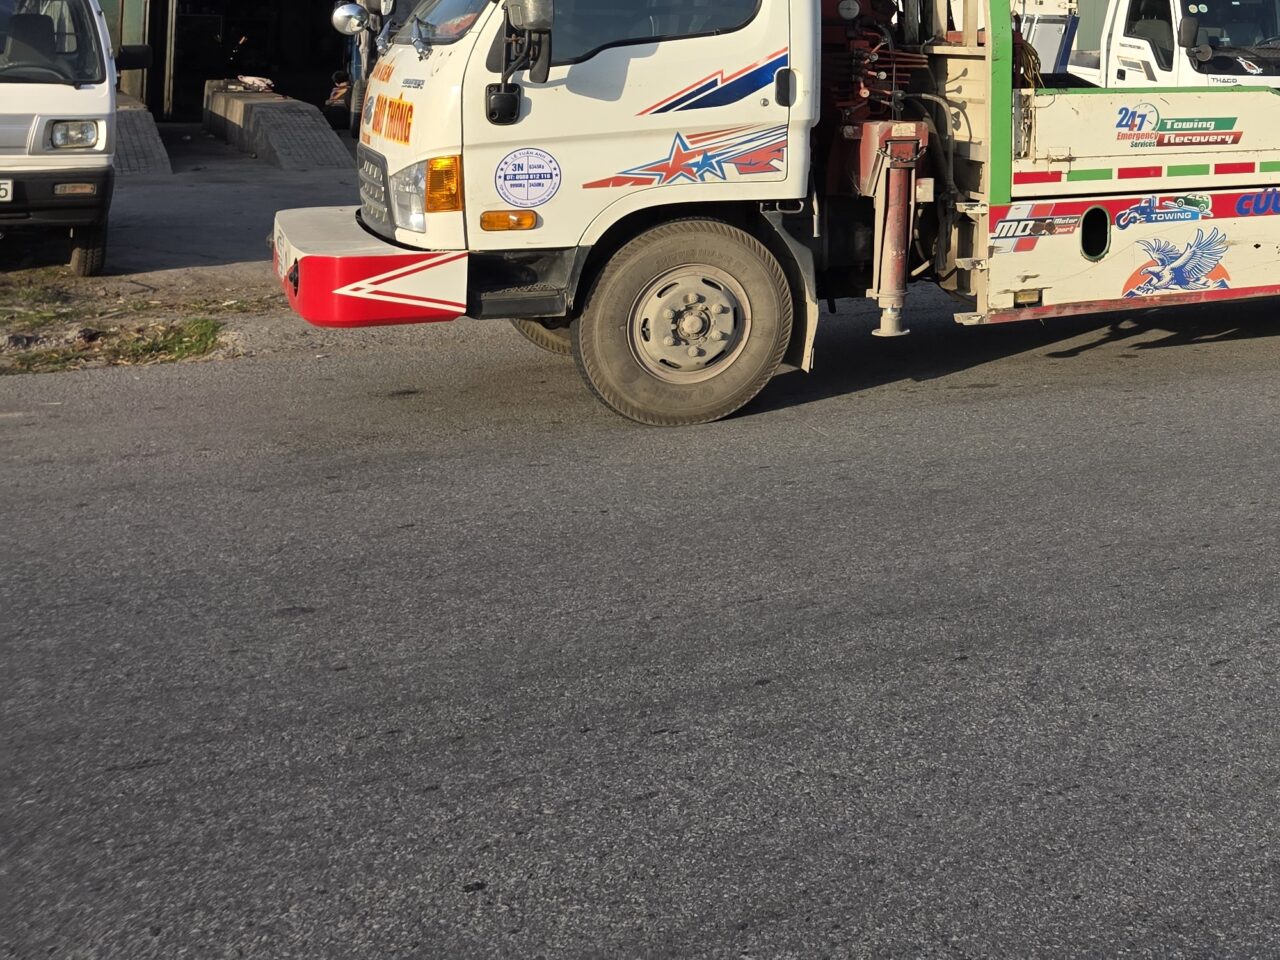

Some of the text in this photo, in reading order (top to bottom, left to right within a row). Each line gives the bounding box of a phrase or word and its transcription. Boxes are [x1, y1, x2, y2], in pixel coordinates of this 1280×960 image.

[1164, 119, 1215, 131] Towing
[1117, 131, 1160, 142] Emergency
[1163, 133, 1234, 144] Recovery
[1130, 140, 1156, 148] Services
[511, 163, 524, 172] 3N
[1151, 211, 1192, 221] TOWING
